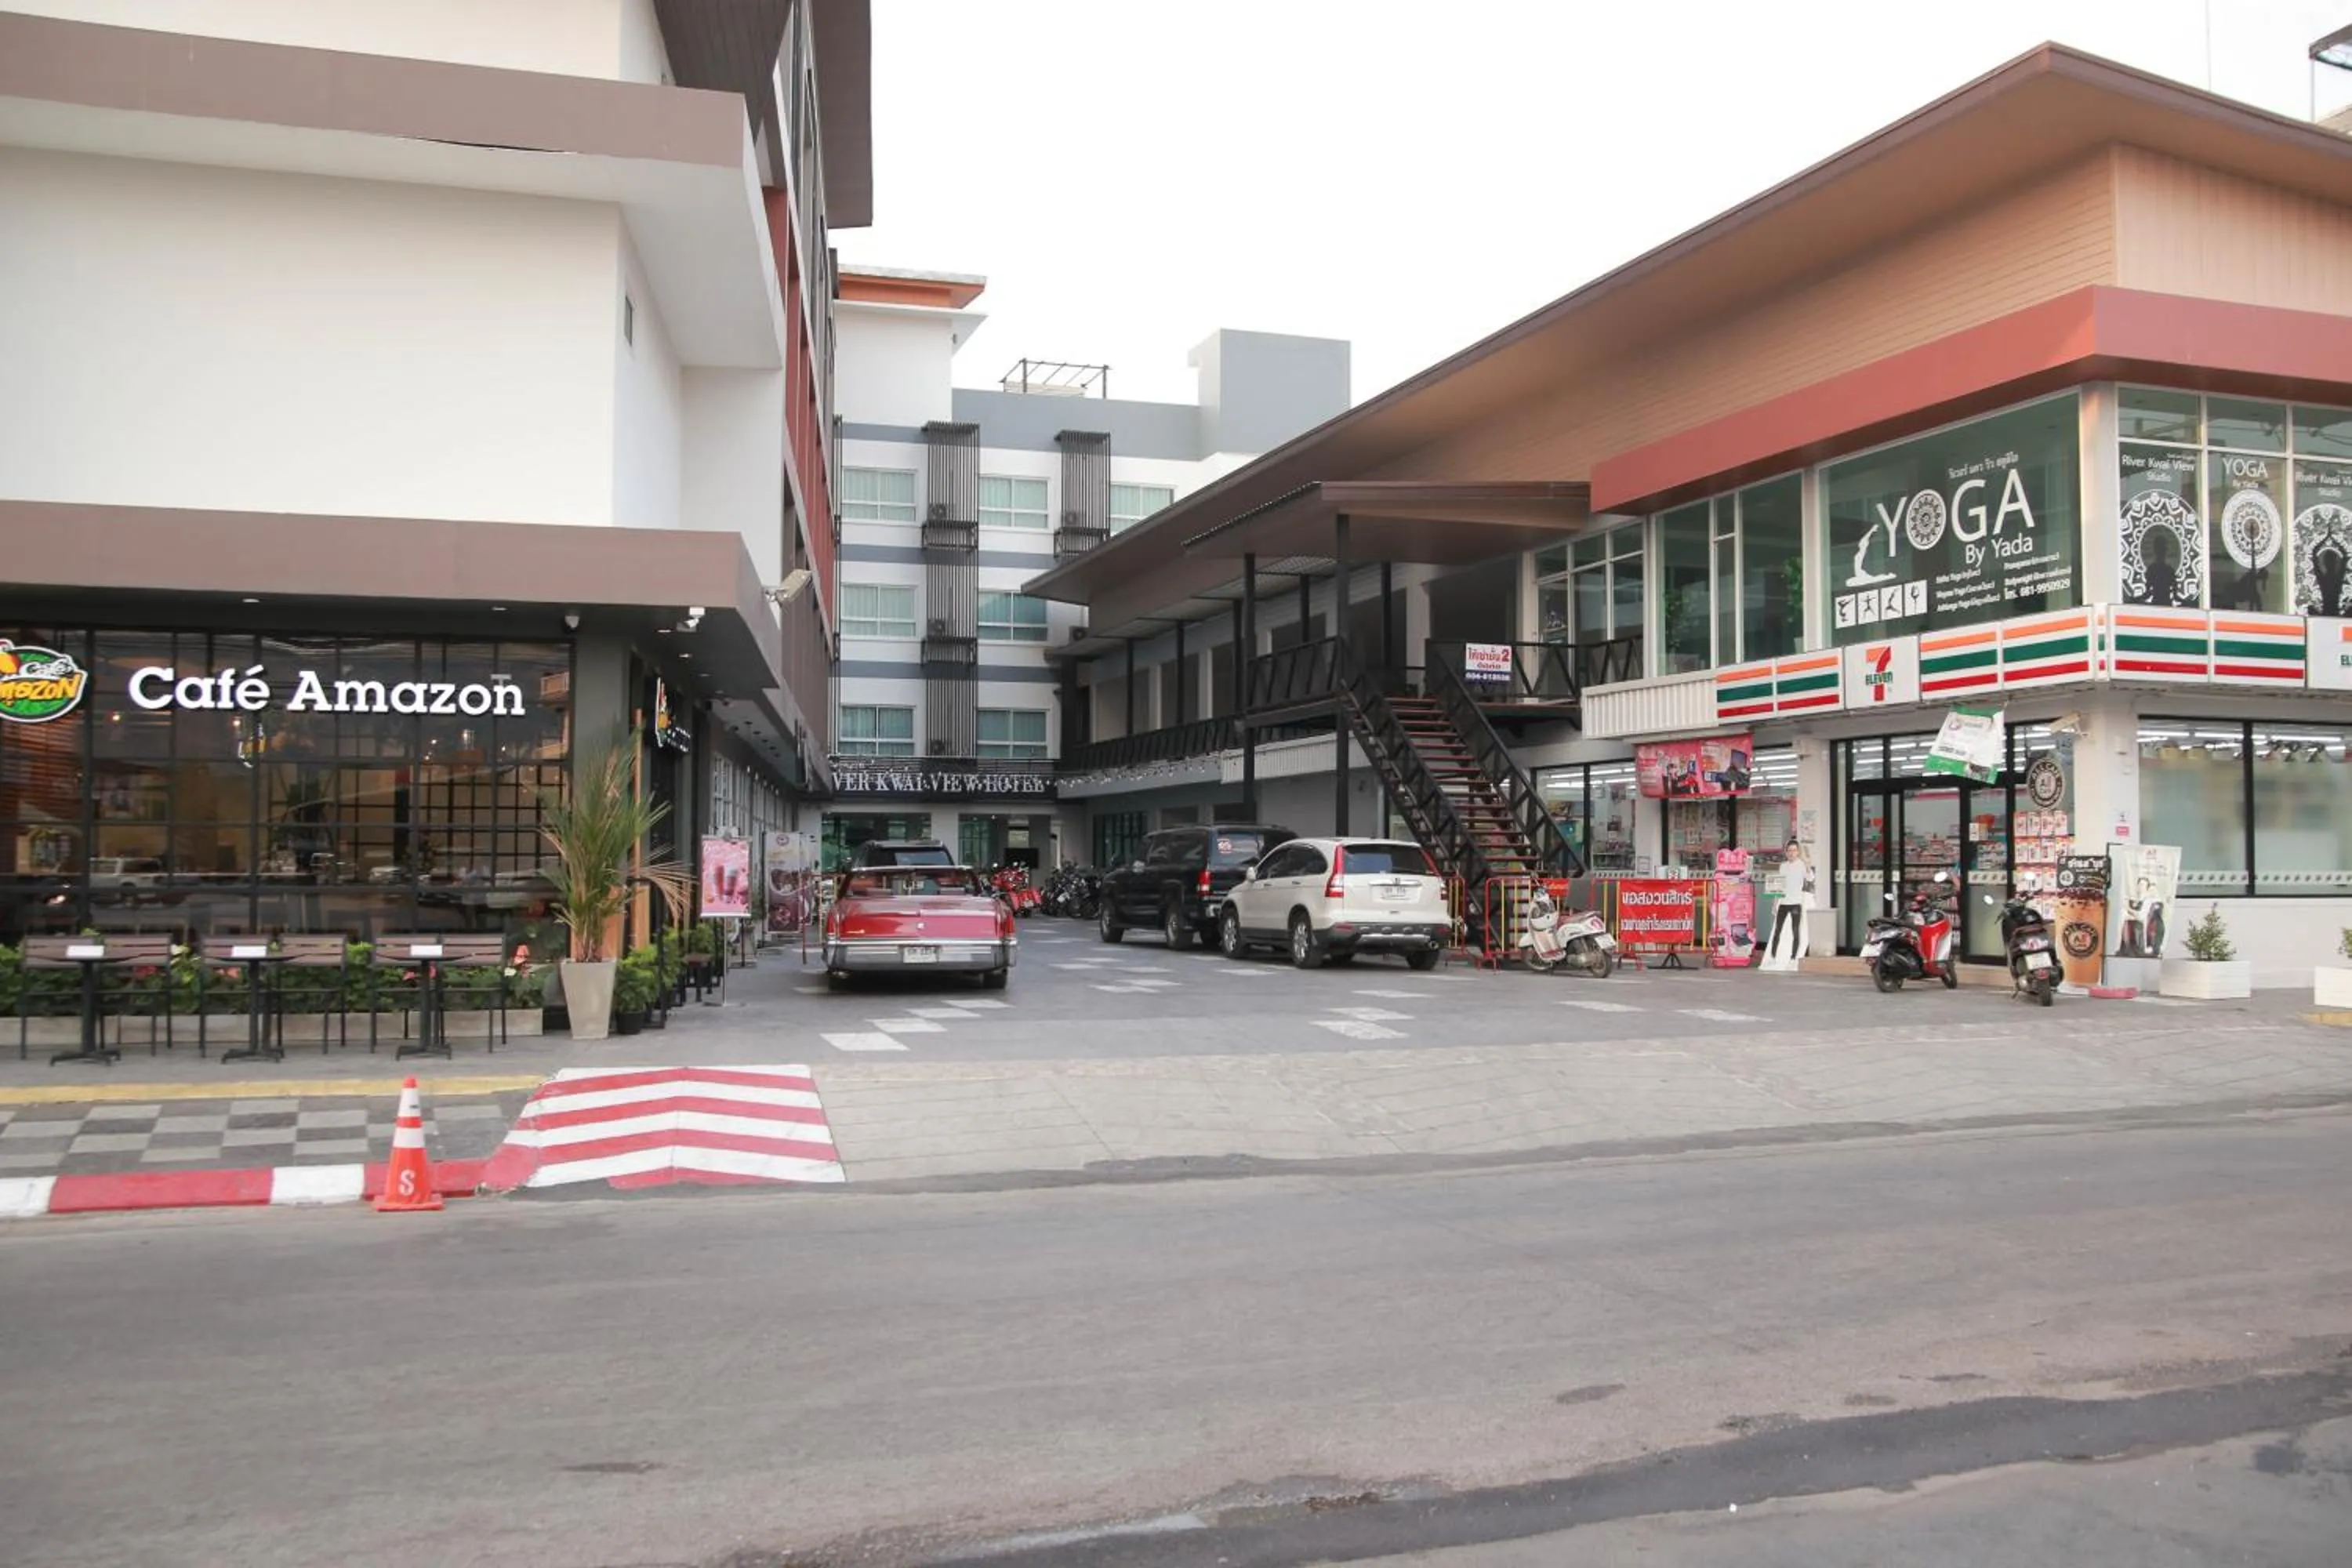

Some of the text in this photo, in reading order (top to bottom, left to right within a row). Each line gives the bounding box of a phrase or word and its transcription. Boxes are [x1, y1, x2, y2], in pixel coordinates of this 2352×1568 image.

[2222, 457, 2268, 478] YOGA
[1876, 468, 2035, 557] YOGA
[1965, 544, 1985, 566] By
[1991, 532, 2034, 558] Yada
[1501, 649, 1509, 662] 2
[1866, 646, 1892, 701] 7
[129, 664, 525, 716] Café Amazon
[832, 771, 1044, 793] VER KWAI VIEW HOTEL
[398, 1169, 416, 1196] S
